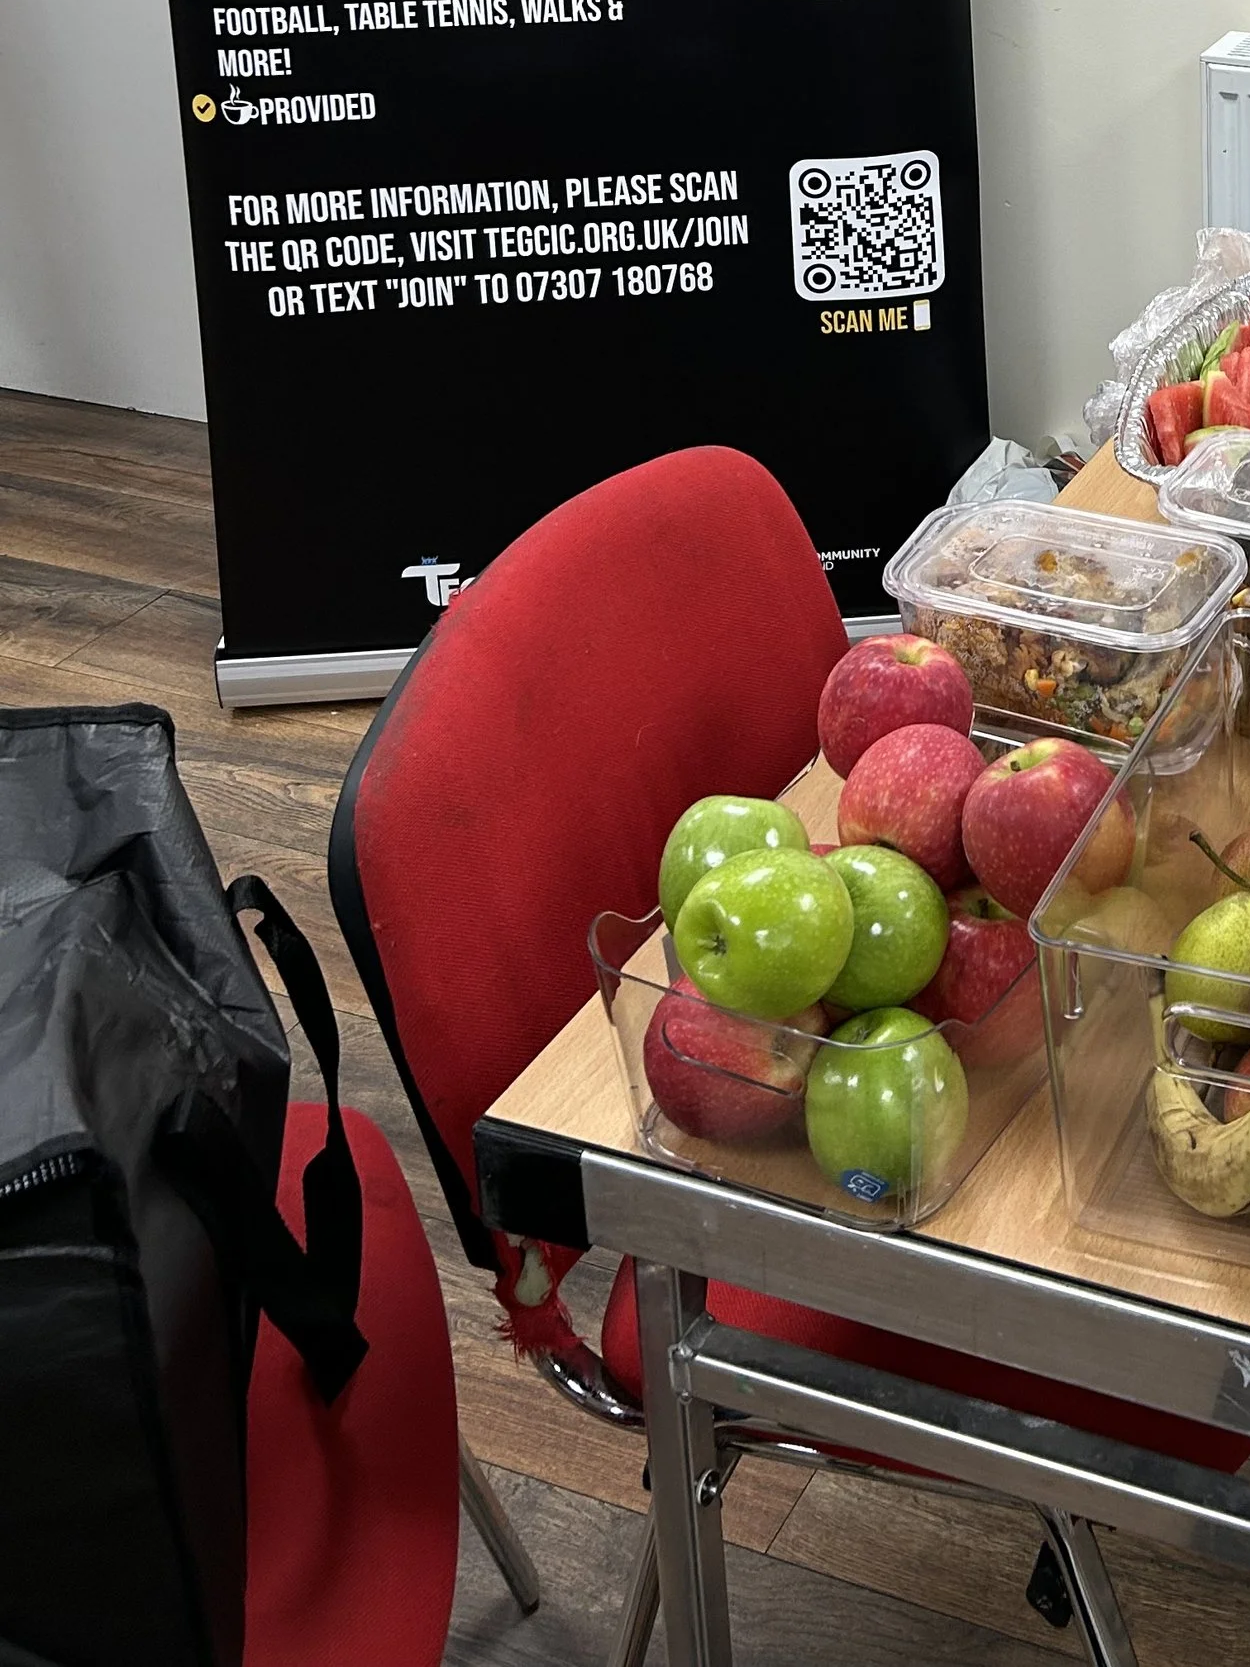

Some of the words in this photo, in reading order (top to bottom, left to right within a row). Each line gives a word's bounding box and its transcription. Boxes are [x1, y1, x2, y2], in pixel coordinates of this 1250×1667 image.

[213, 4, 340, 36] FOOTBALL,
[343, 0, 419, 31] TABLE
[217, 47, 292, 78] MORE!
[259, 92, 376, 125] PROVIDED
[228, 195, 280, 227] FOR
[285, 189, 365, 225] MORE
[370, 179, 559, 219] INFORMATION,
[565, 173, 664, 209] PLEASE
[669, 170, 738, 203] SCAN
[224, 240, 277, 272] THE
[281, 238, 320, 273] QR
[325, 233, 404, 268] CODE,
[409, 228, 477, 262] VISIT
[482, 214, 749, 259] TEGCIC.ORG.UK/JOIN
[268, 285, 306, 317] OR
[309, 279, 378, 314] TEXT
[385, 275, 467, 309] "JOIN"
[474, 272, 509, 304] TO
[515, 267, 602, 303] 07307
[611, 261, 714, 297] 180768
[820, 309, 873, 334] SCAN
[878, 306, 909, 332] ME
[816, 547, 881, 562] MMUNITY
[401, 562, 476, 606] TE
